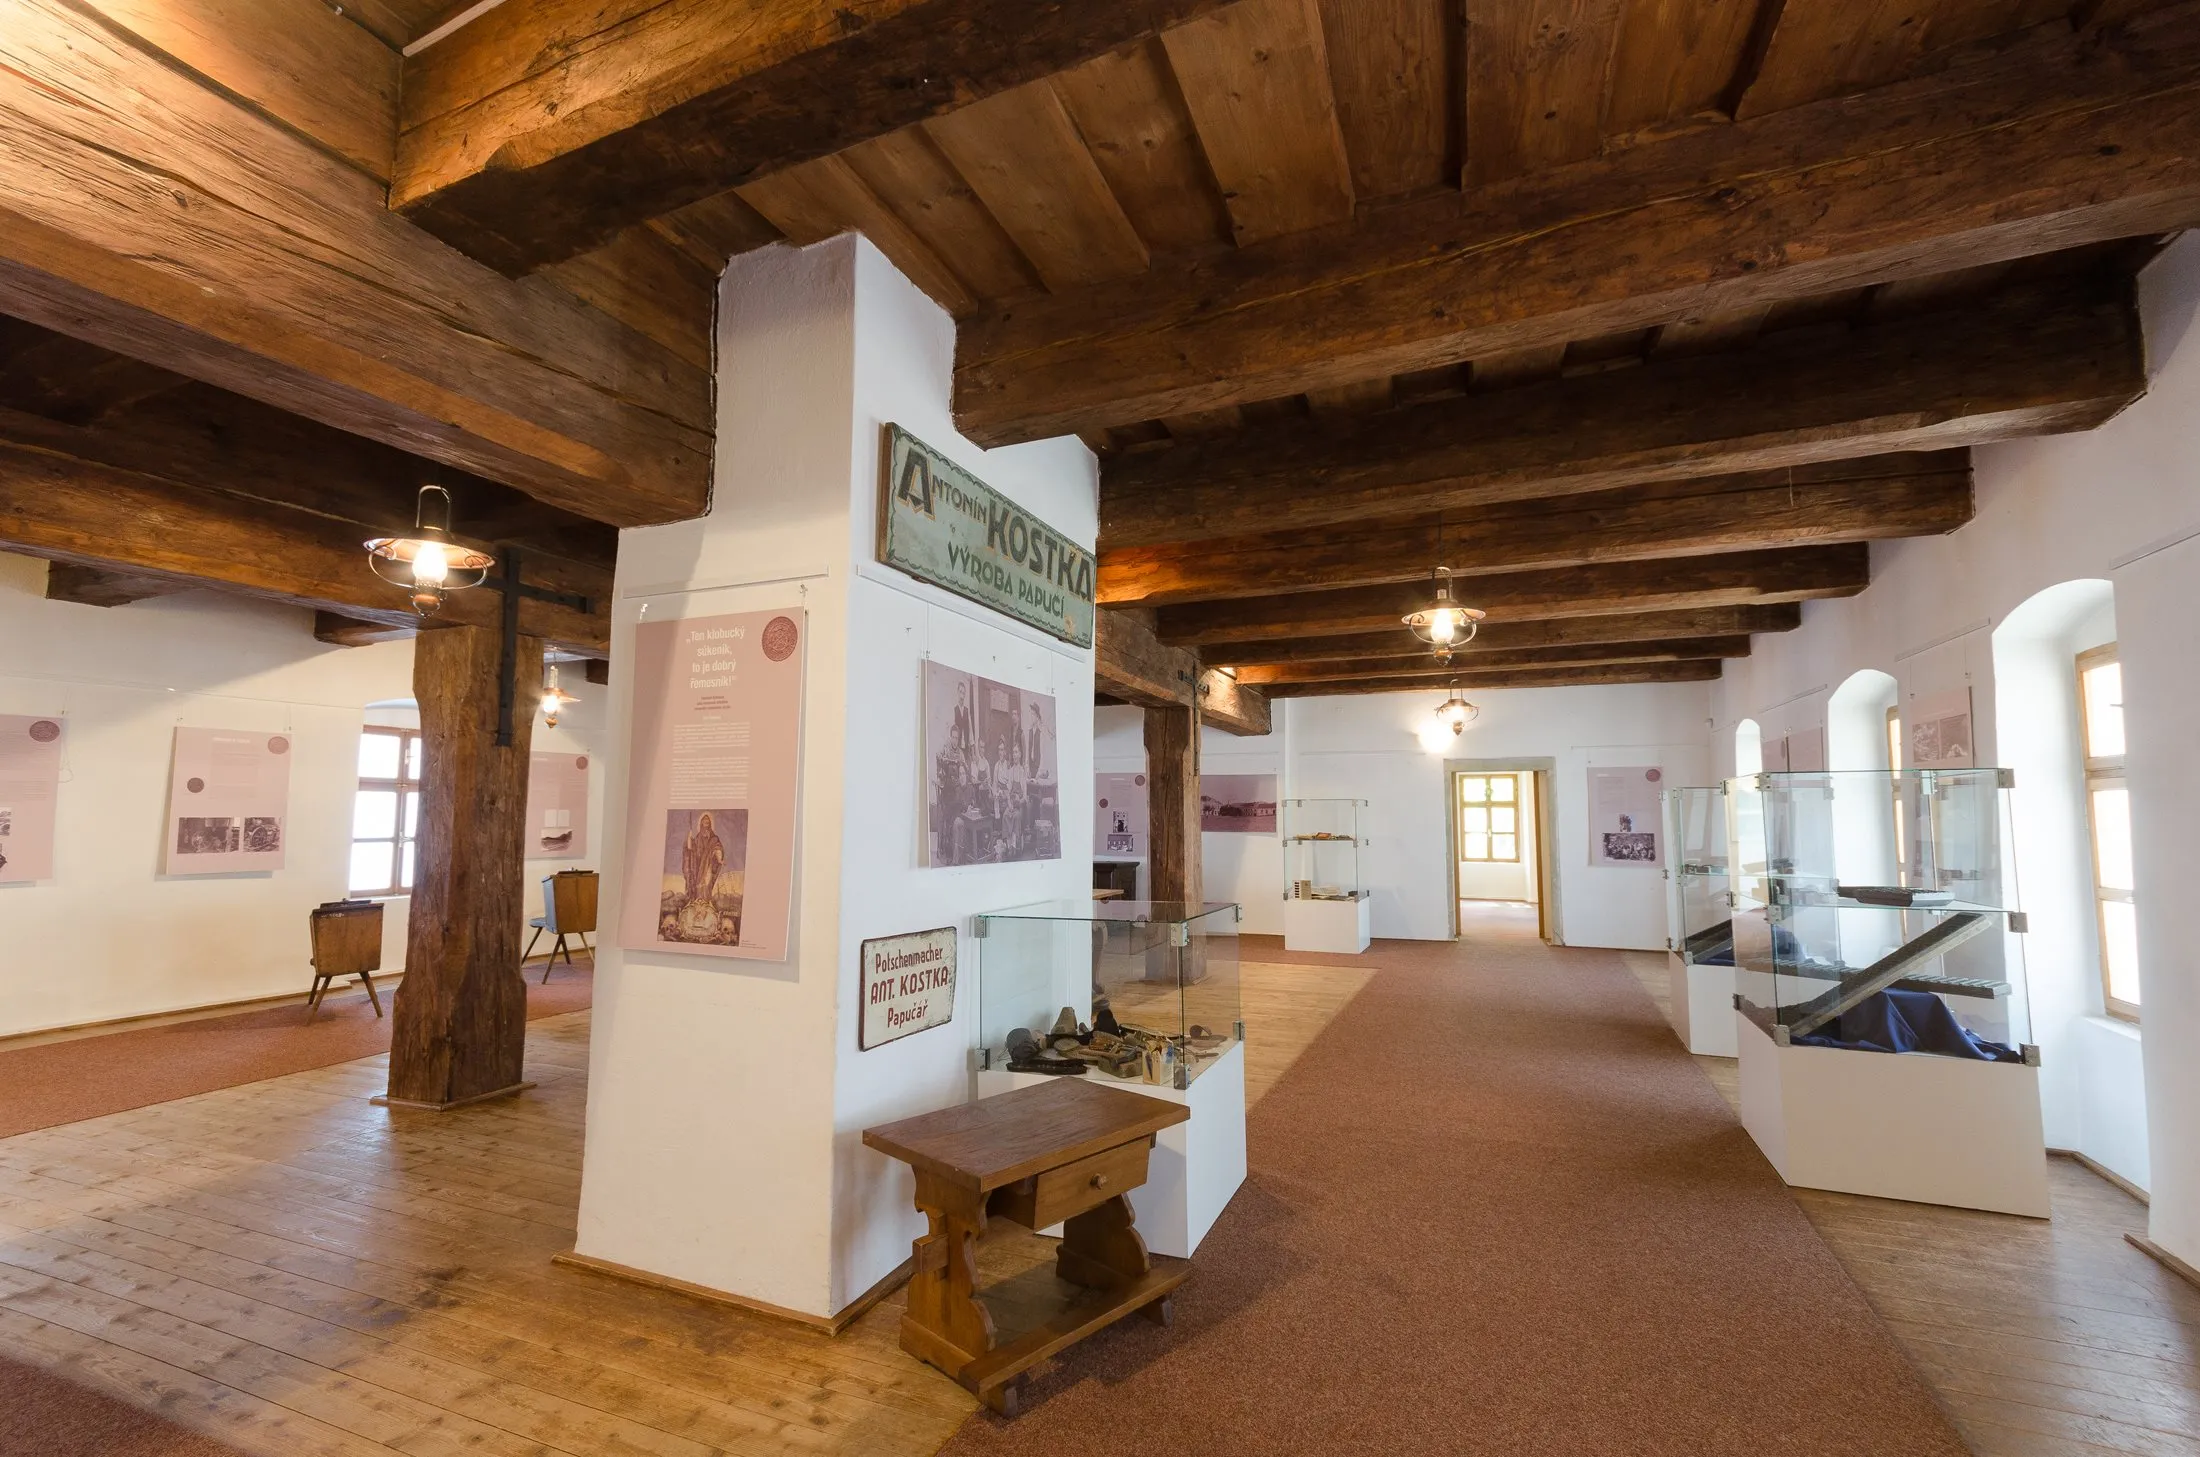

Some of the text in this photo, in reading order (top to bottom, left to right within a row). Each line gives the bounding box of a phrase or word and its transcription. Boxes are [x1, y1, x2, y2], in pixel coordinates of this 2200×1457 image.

[948, 542, 1013, 595] VÝROBA
[987, 498, 1092, 602] KOSTKA
[706, 625, 745, 640] klobucký
[692, 658, 737, 674] to je dobrý
[871, 966, 949, 1005] ANT. KOSTKA
